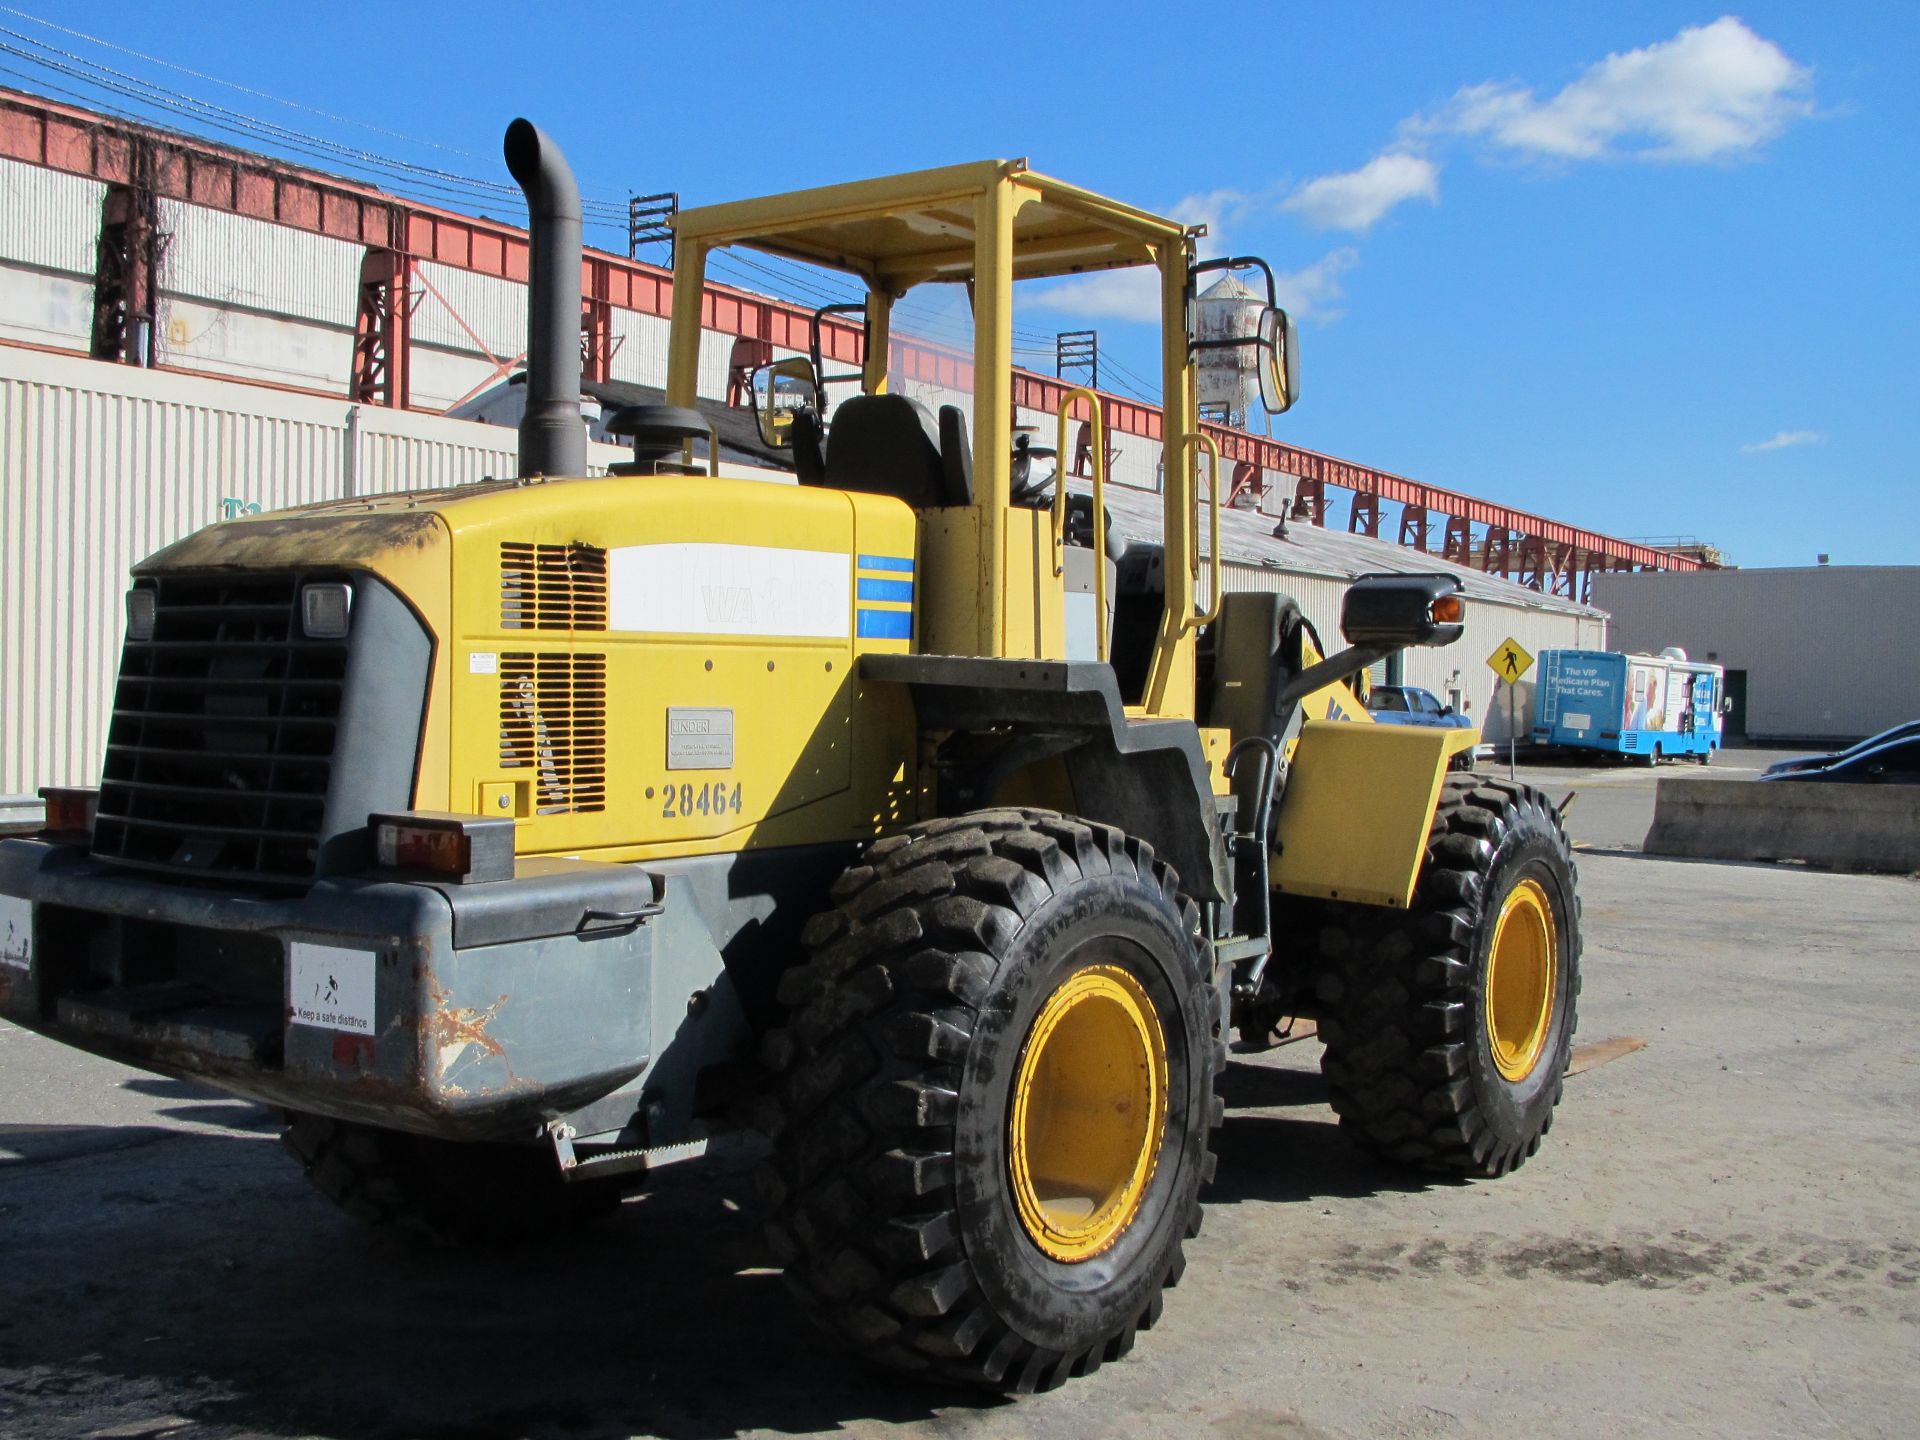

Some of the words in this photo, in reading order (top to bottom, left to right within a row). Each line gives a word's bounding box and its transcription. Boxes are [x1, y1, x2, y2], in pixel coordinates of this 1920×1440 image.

[1565, 667, 1581, 676] The
[1583, 668, 1598, 677] VIP
[1590, 678, 1610, 687] Plan
[1558, 686, 1575, 695] That
[662, 782, 743, 818] 28464
[299, 1007, 315, 1023] Keep
[322, 1013, 336, 1024] safe
